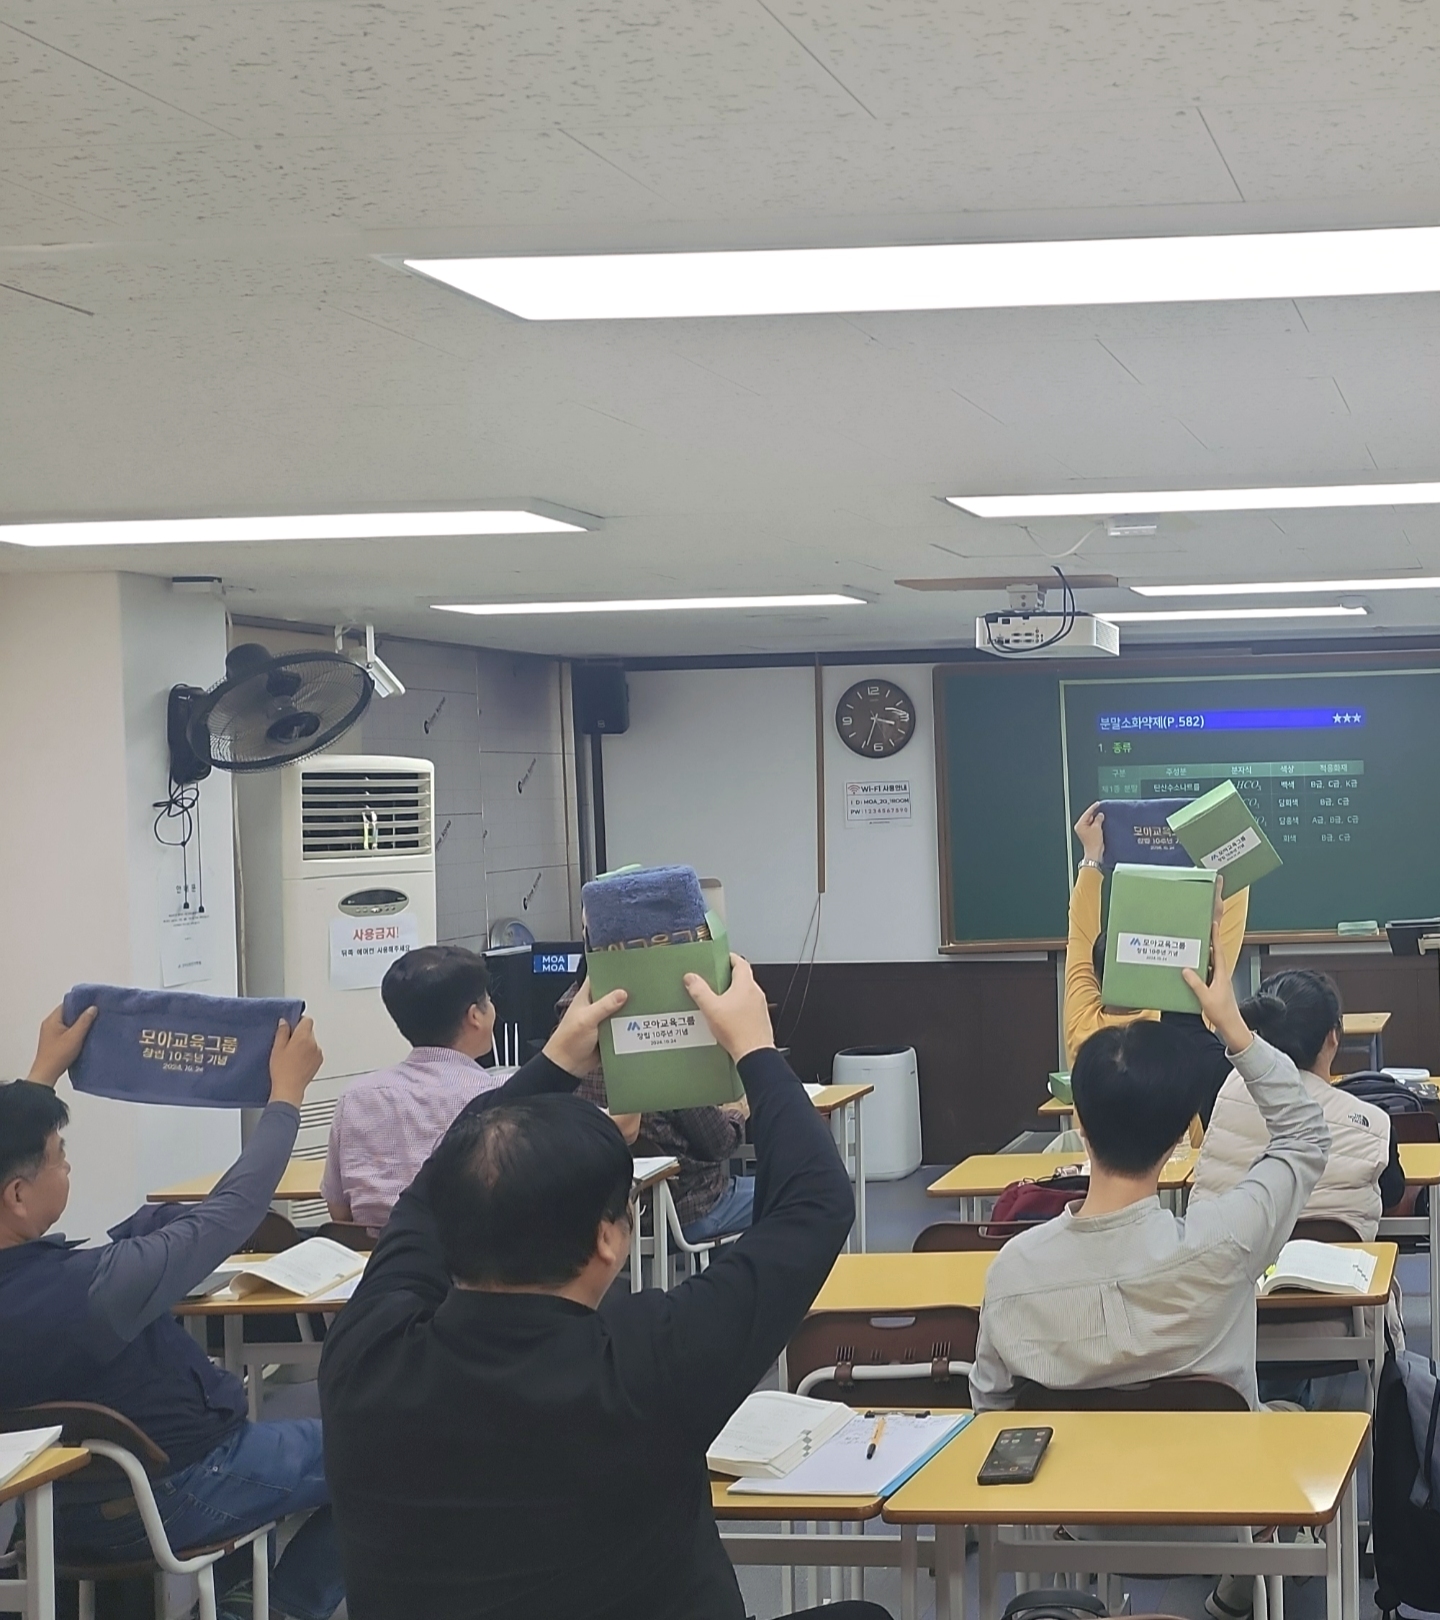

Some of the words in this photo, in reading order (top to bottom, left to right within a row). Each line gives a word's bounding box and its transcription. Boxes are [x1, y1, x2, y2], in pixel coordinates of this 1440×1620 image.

[868, 686, 880, 695] 12
[842, 716, 853, 726] 9
[1100, 716, 1205, 730] 분말소화약제(P.582)
[874, 743, 884, 752] 6
[1098, 743, 1107, 753] 1.
[1113, 742, 1131, 753] 종류
[1166, 768, 1187, 776] 주성분
[1231, 766, 1252, 775] 분자식
[1280, 765, 1295, 774] 색상
[1320, 764, 1348, 772] 적응화재
[1280, 780, 1295, 789] 백색
[1133, 826, 1176, 837] 모아교육
[353, 926, 399, 941] 사용금지!
[1143, 939, 1186, 950] 모아교육그룹
[542, 955, 565, 964] MOA
[542, 964, 565, 972] MOA
[643, 1016, 695, 1029] 모아교육그룹
[637, 1032, 650, 1040] 창립
[652, 1030, 673, 1038] 10주년
[675, 1028, 689, 1036] 기념
[139, 1029, 237, 1054] 모아교육그룹
[142, 1047, 165, 1060] 창립
[168, 1051, 204, 1064] 10주년
[207, 1054, 228, 1066] 기념
